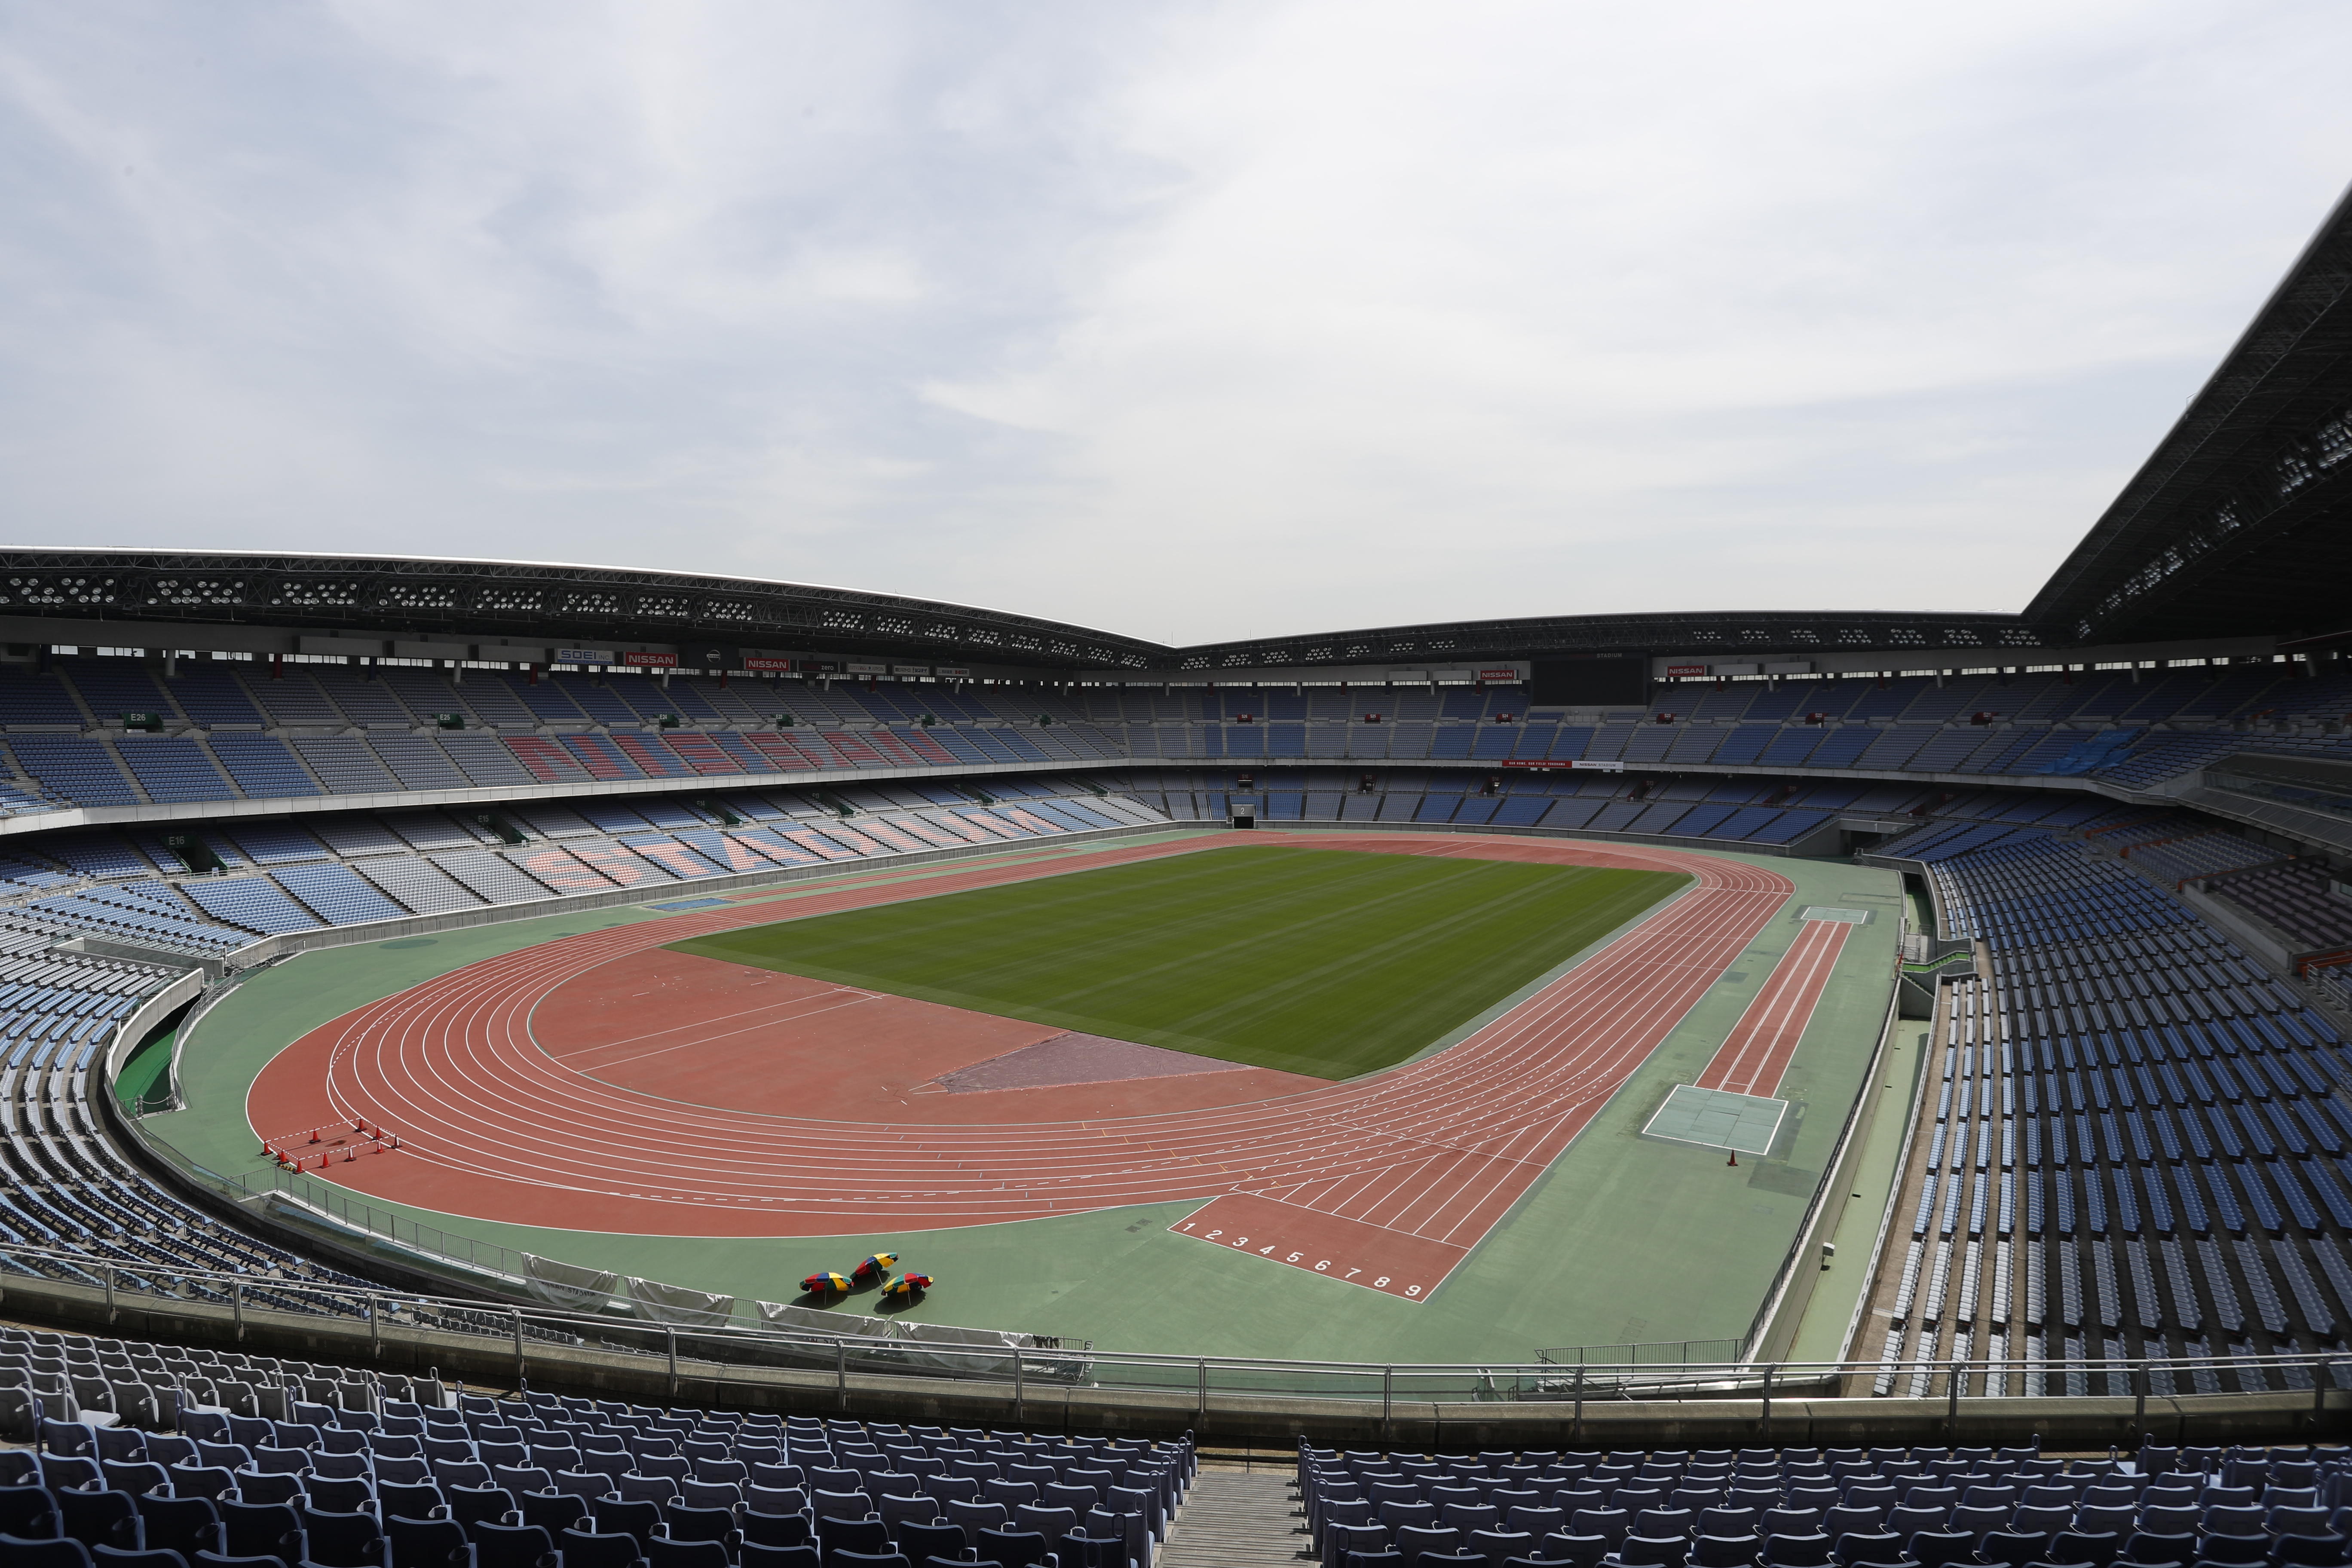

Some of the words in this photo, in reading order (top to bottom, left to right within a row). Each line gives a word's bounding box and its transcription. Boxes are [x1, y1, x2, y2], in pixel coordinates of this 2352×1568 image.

[561, 650, 596, 660] SOEI
[629, 655, 674, 664] NISSAN
[749, 660, 787, 668] NISSAN
[1874, 823, 1878, 832] 1
[169, 836, 185, 845] E16
[527, 810, 1067, 889] STADIUM
[1183, 1223, 1196, 1231] 1
[1205, 1230, 1222, 1240] 2
[1232, 1237, 1249, 1246] 3
[1259, 1246, 1276, 1255] 4
[1286, 1252, 1304, 1262] 5
[1314, 1260, 1331, 1271] 6
[1344, 1268, 1362, 1278] 7
[1374, 1277, 1390, 1287] 8
[1405, 1285, 1421, 1296] 9
